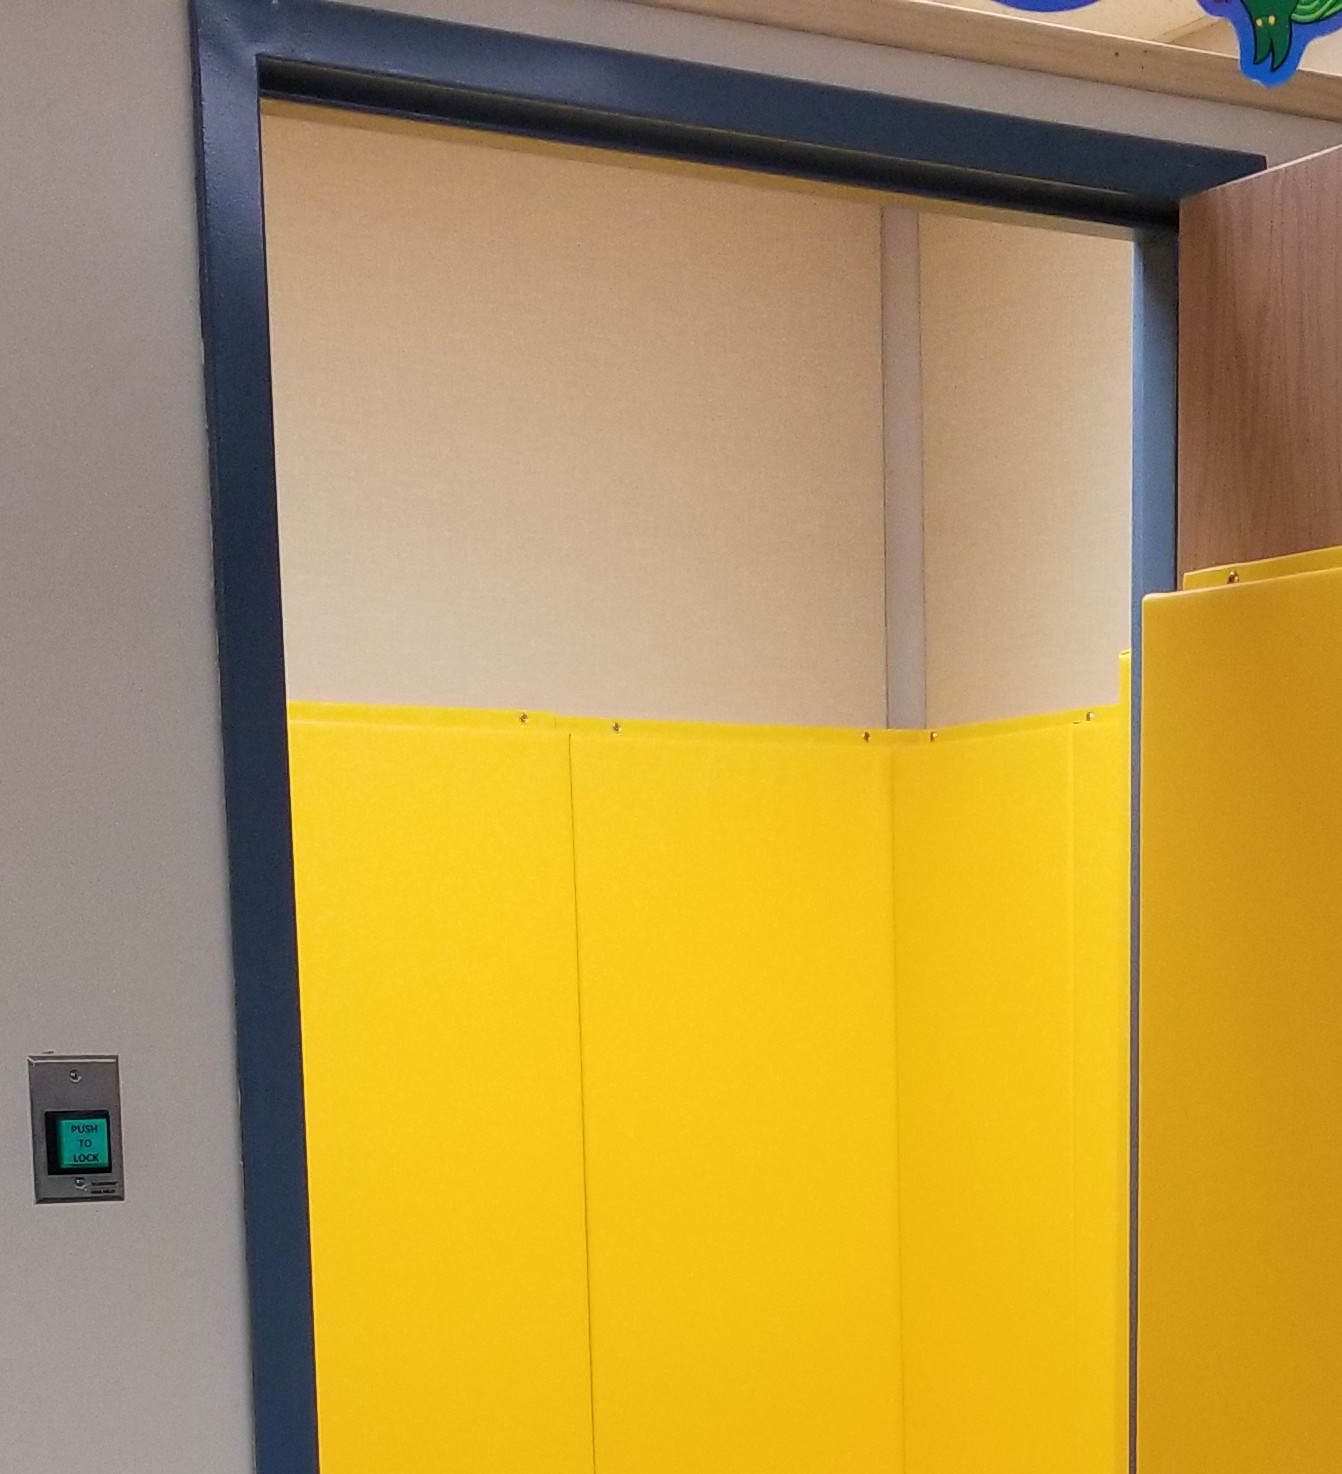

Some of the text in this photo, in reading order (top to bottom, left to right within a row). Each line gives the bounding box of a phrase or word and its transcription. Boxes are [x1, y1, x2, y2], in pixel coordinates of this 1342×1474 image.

[71, 1124, 98, 1134] PUSH
[78, 1139, 92, 1148] TO
[73, 1153, 100, 1163] LOCK
